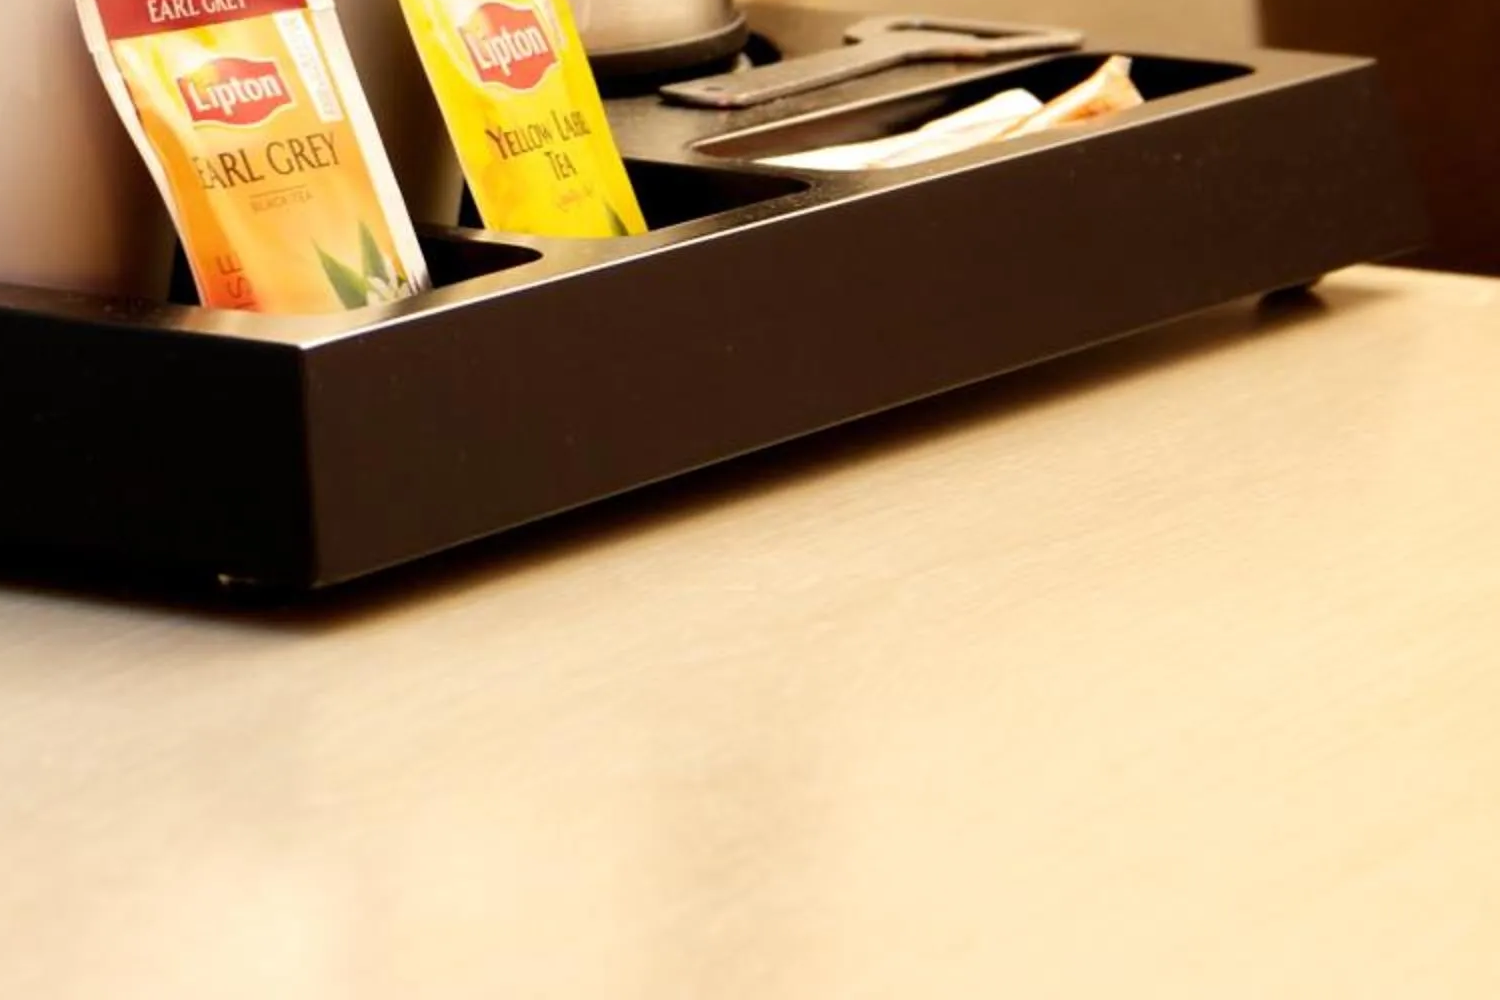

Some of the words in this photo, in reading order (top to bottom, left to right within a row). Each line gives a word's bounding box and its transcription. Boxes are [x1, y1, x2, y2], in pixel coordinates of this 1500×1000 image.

[464, 25, 549, 77] Lipton
[187, 74, 283, 117] Lipton
[192, 148, 265, 190] EARL
[266, 130, 340, 176] GREY
[543, 150, 578, 182] TEA
